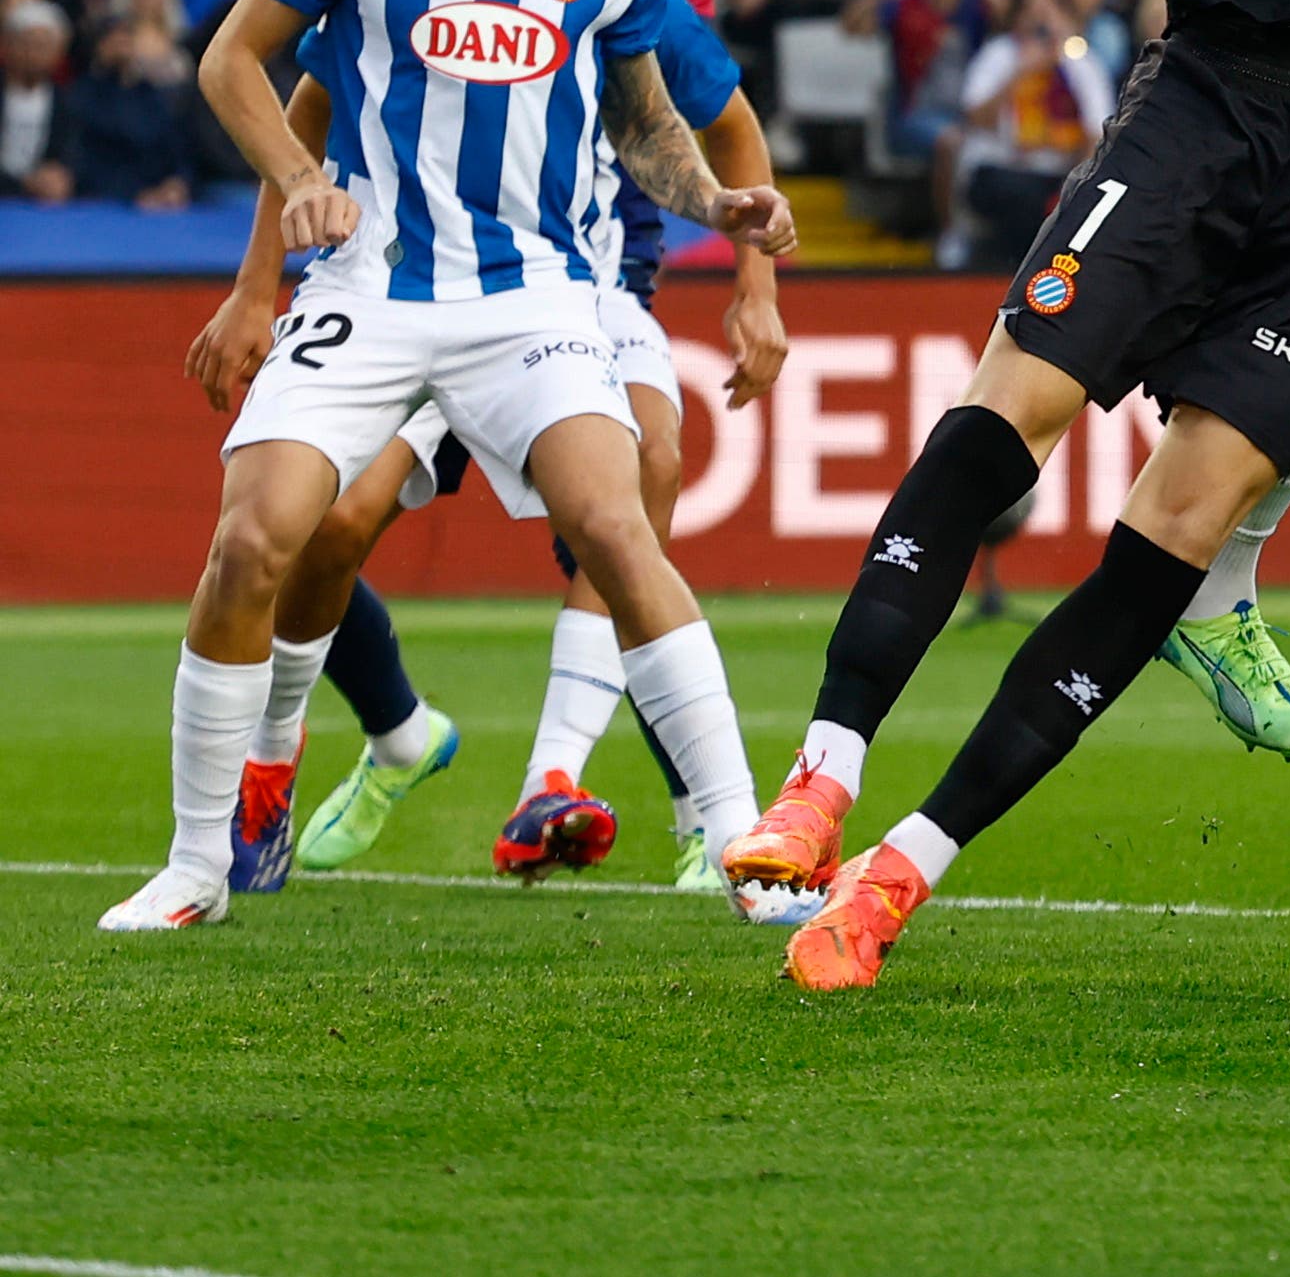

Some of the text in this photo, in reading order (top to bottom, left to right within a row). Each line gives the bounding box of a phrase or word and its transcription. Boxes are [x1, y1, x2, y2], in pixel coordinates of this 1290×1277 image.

[425, 17, 540, 67] DANI
[1068, 178, 1128, 253] 1
[523, 340, 610, 369] SKO
[873, 553, 919, 573] KELME
[1054, 679, 1092, 716] KELME
